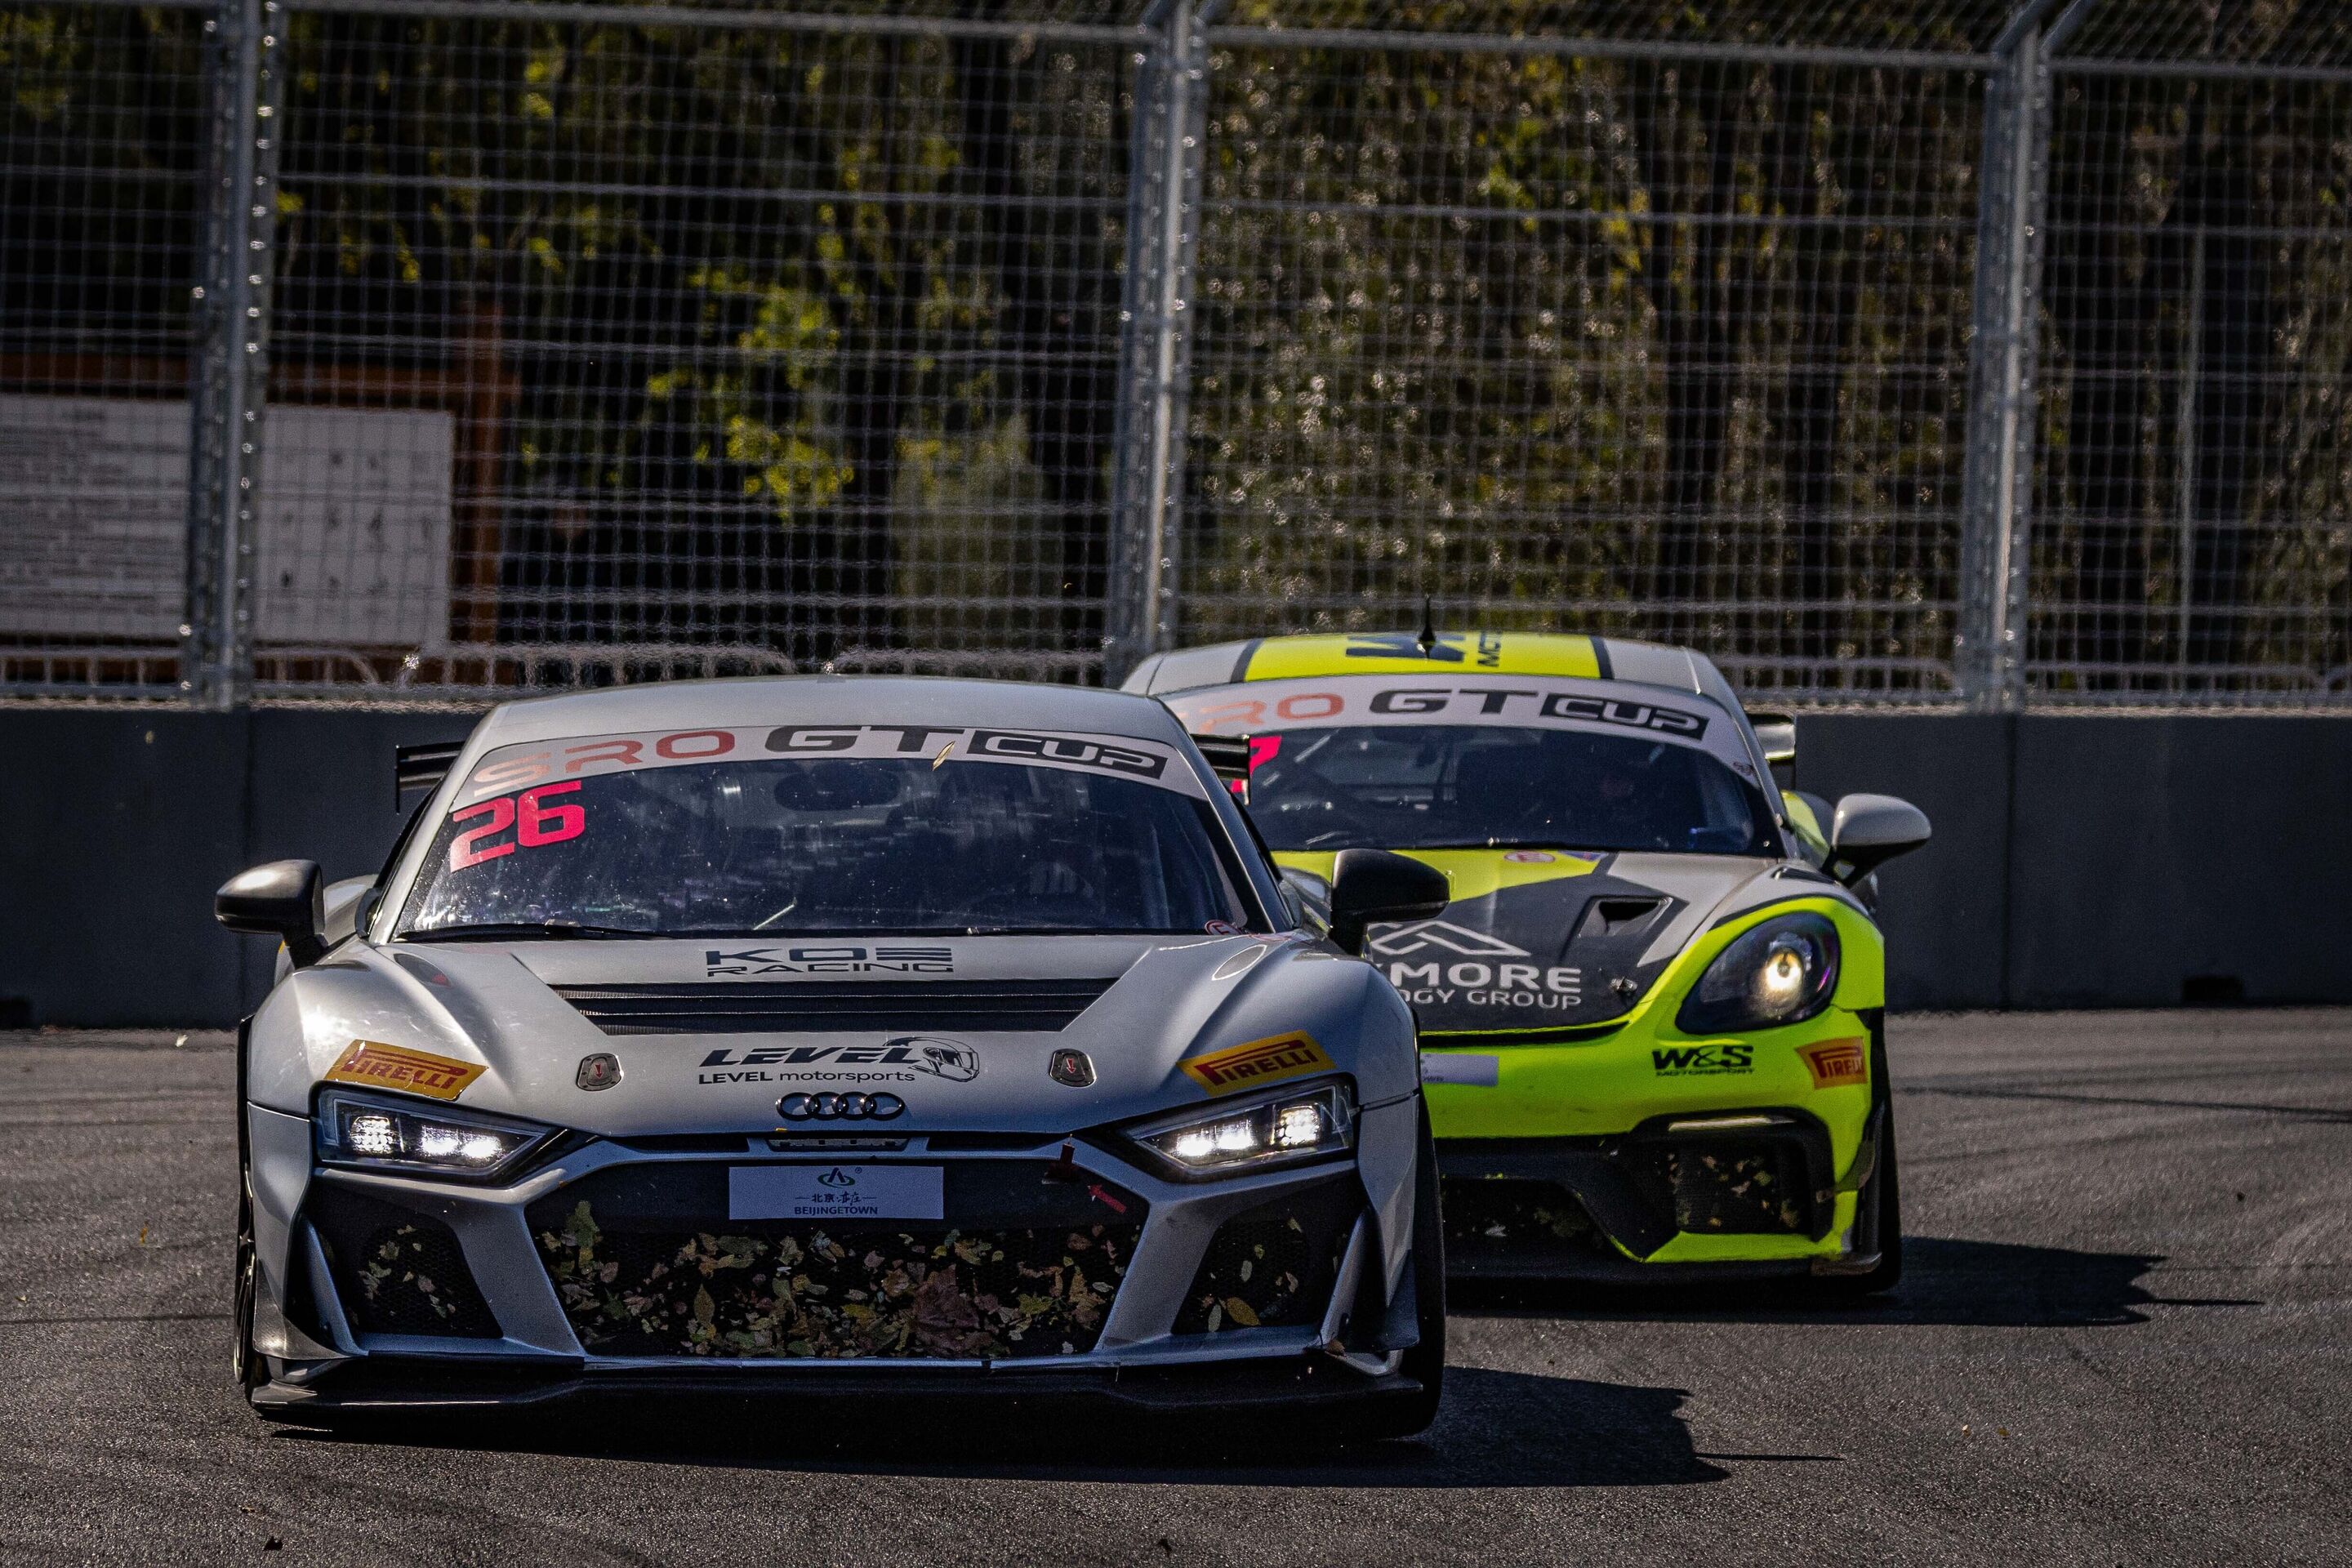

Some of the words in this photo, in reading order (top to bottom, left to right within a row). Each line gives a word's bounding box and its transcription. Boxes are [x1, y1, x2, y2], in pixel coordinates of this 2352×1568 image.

[1176, 693, 1345, 733] RO
[1368, 688, 1538, 715] GT
[1548, 694, 1704, 737] CUP
[474, 730, 736, 797] SRO
[764, 725, 966, 753] GT
[978, 731, 1164, 776] CUP
[450, 780, 586, 873] 26
[707, 962, 955, 978] RACING
[1376, 962, 1582, 994] MORE
[1467, 989, 1582, 1010] GROUP
[341, 1043, 469, 1090] PIRELLI
[699, 1046, 923, 1067] LEVEL
[1193, 1040, 1320, 1087] PIRELLI
[1652, 1045, 1754, 1070] W&S
[698, 1071, 773, 1085] LEVEL
[780, 1070, 915, 1083] motorsports
[795, 1206, 878, 1216] BEIJINGETOWN
